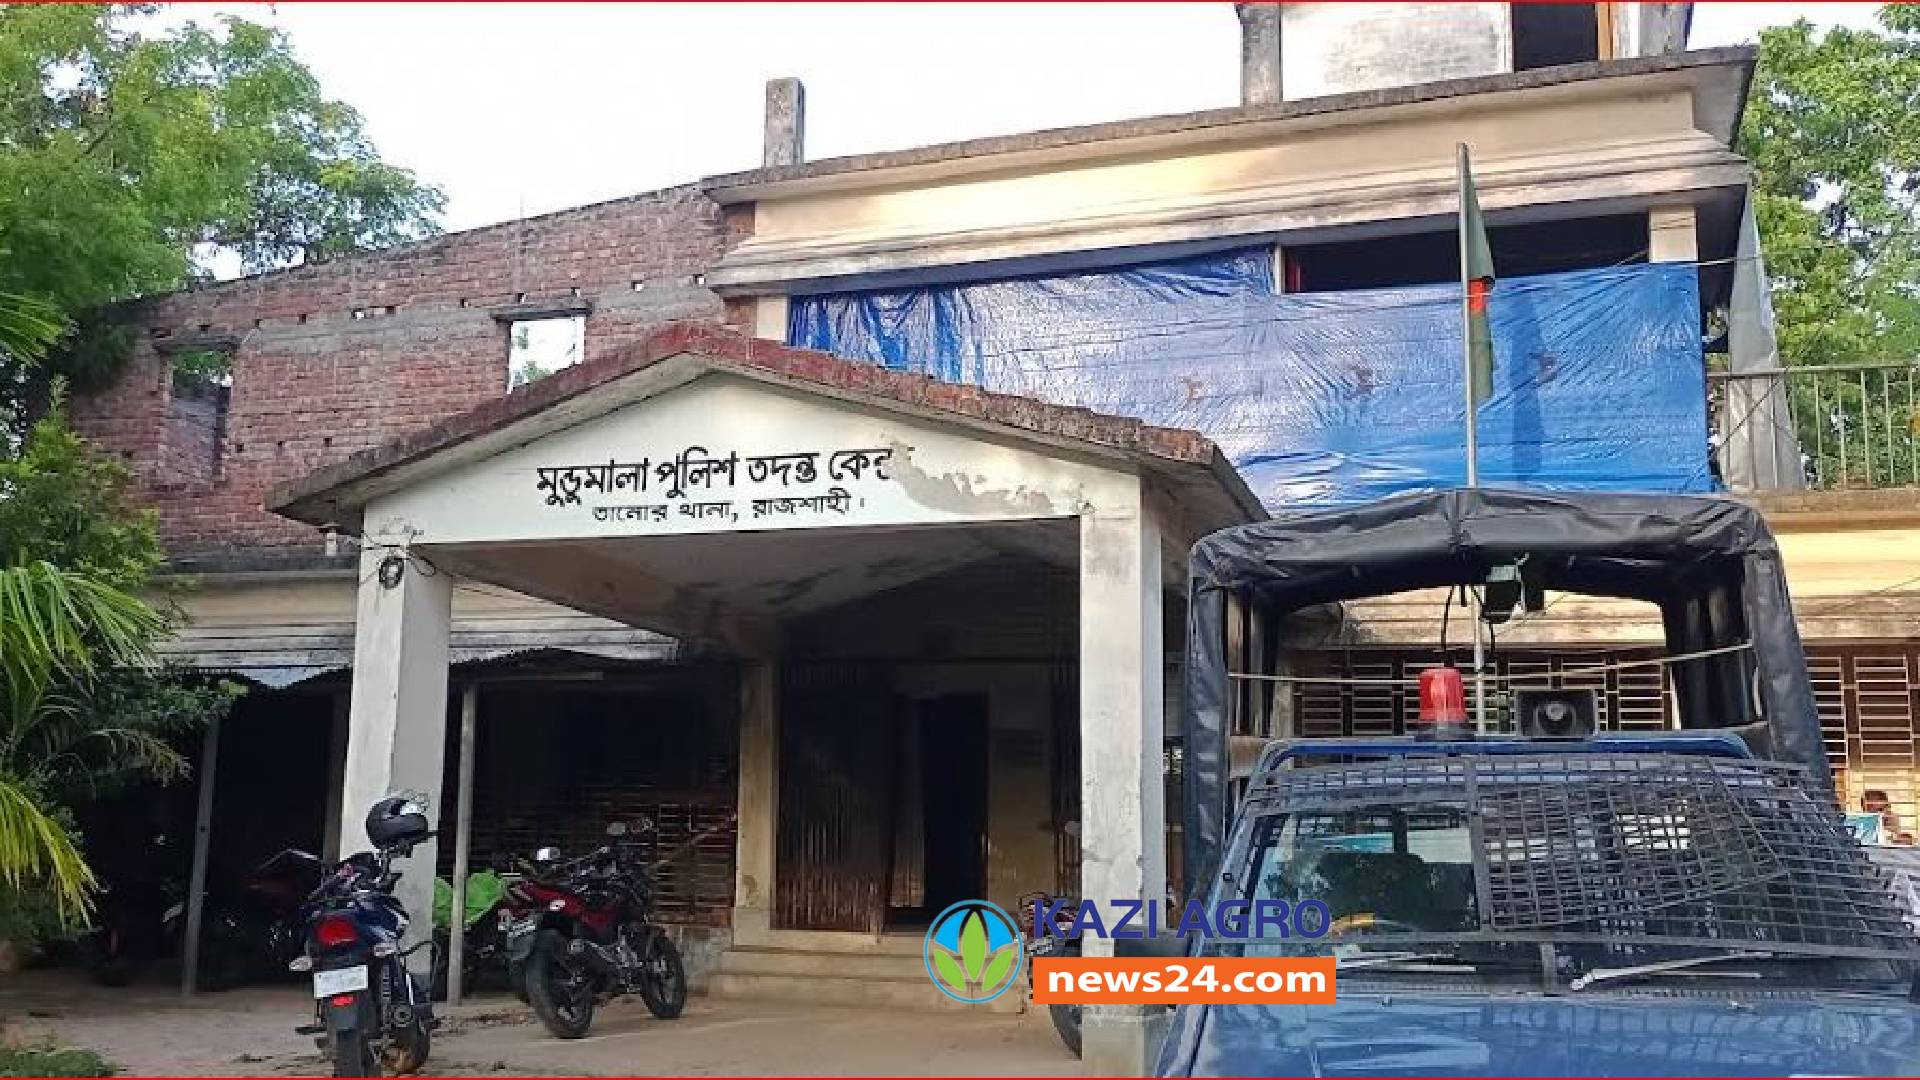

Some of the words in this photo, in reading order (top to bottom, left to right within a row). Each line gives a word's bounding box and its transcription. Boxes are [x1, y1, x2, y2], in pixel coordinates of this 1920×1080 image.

[654, 446, 740, 498] পুলিশ
[745, 452, 820, 487] তদন্ত
[592, 504, 668, 522] তানোর
